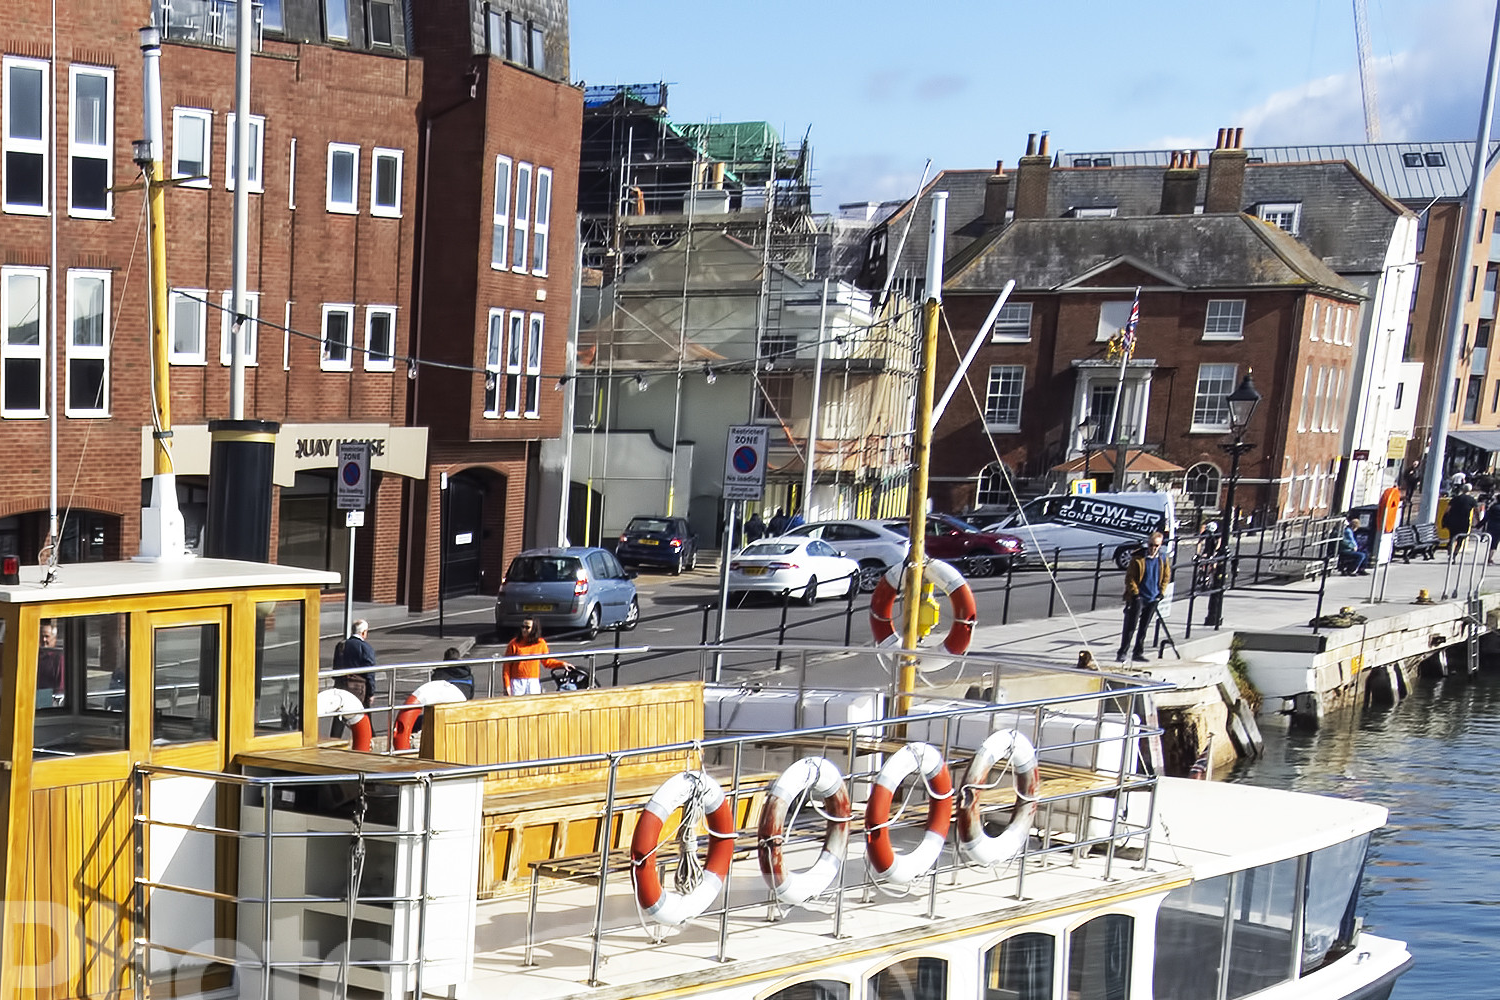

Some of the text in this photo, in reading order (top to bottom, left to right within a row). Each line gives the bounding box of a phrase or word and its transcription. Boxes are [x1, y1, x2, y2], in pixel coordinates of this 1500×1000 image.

[735, 436, 758, 444] ZONE
[1059, 509, 1158, 533] CONSTRUCTION
[1061, 499, 1161, 525] J TOWLER
